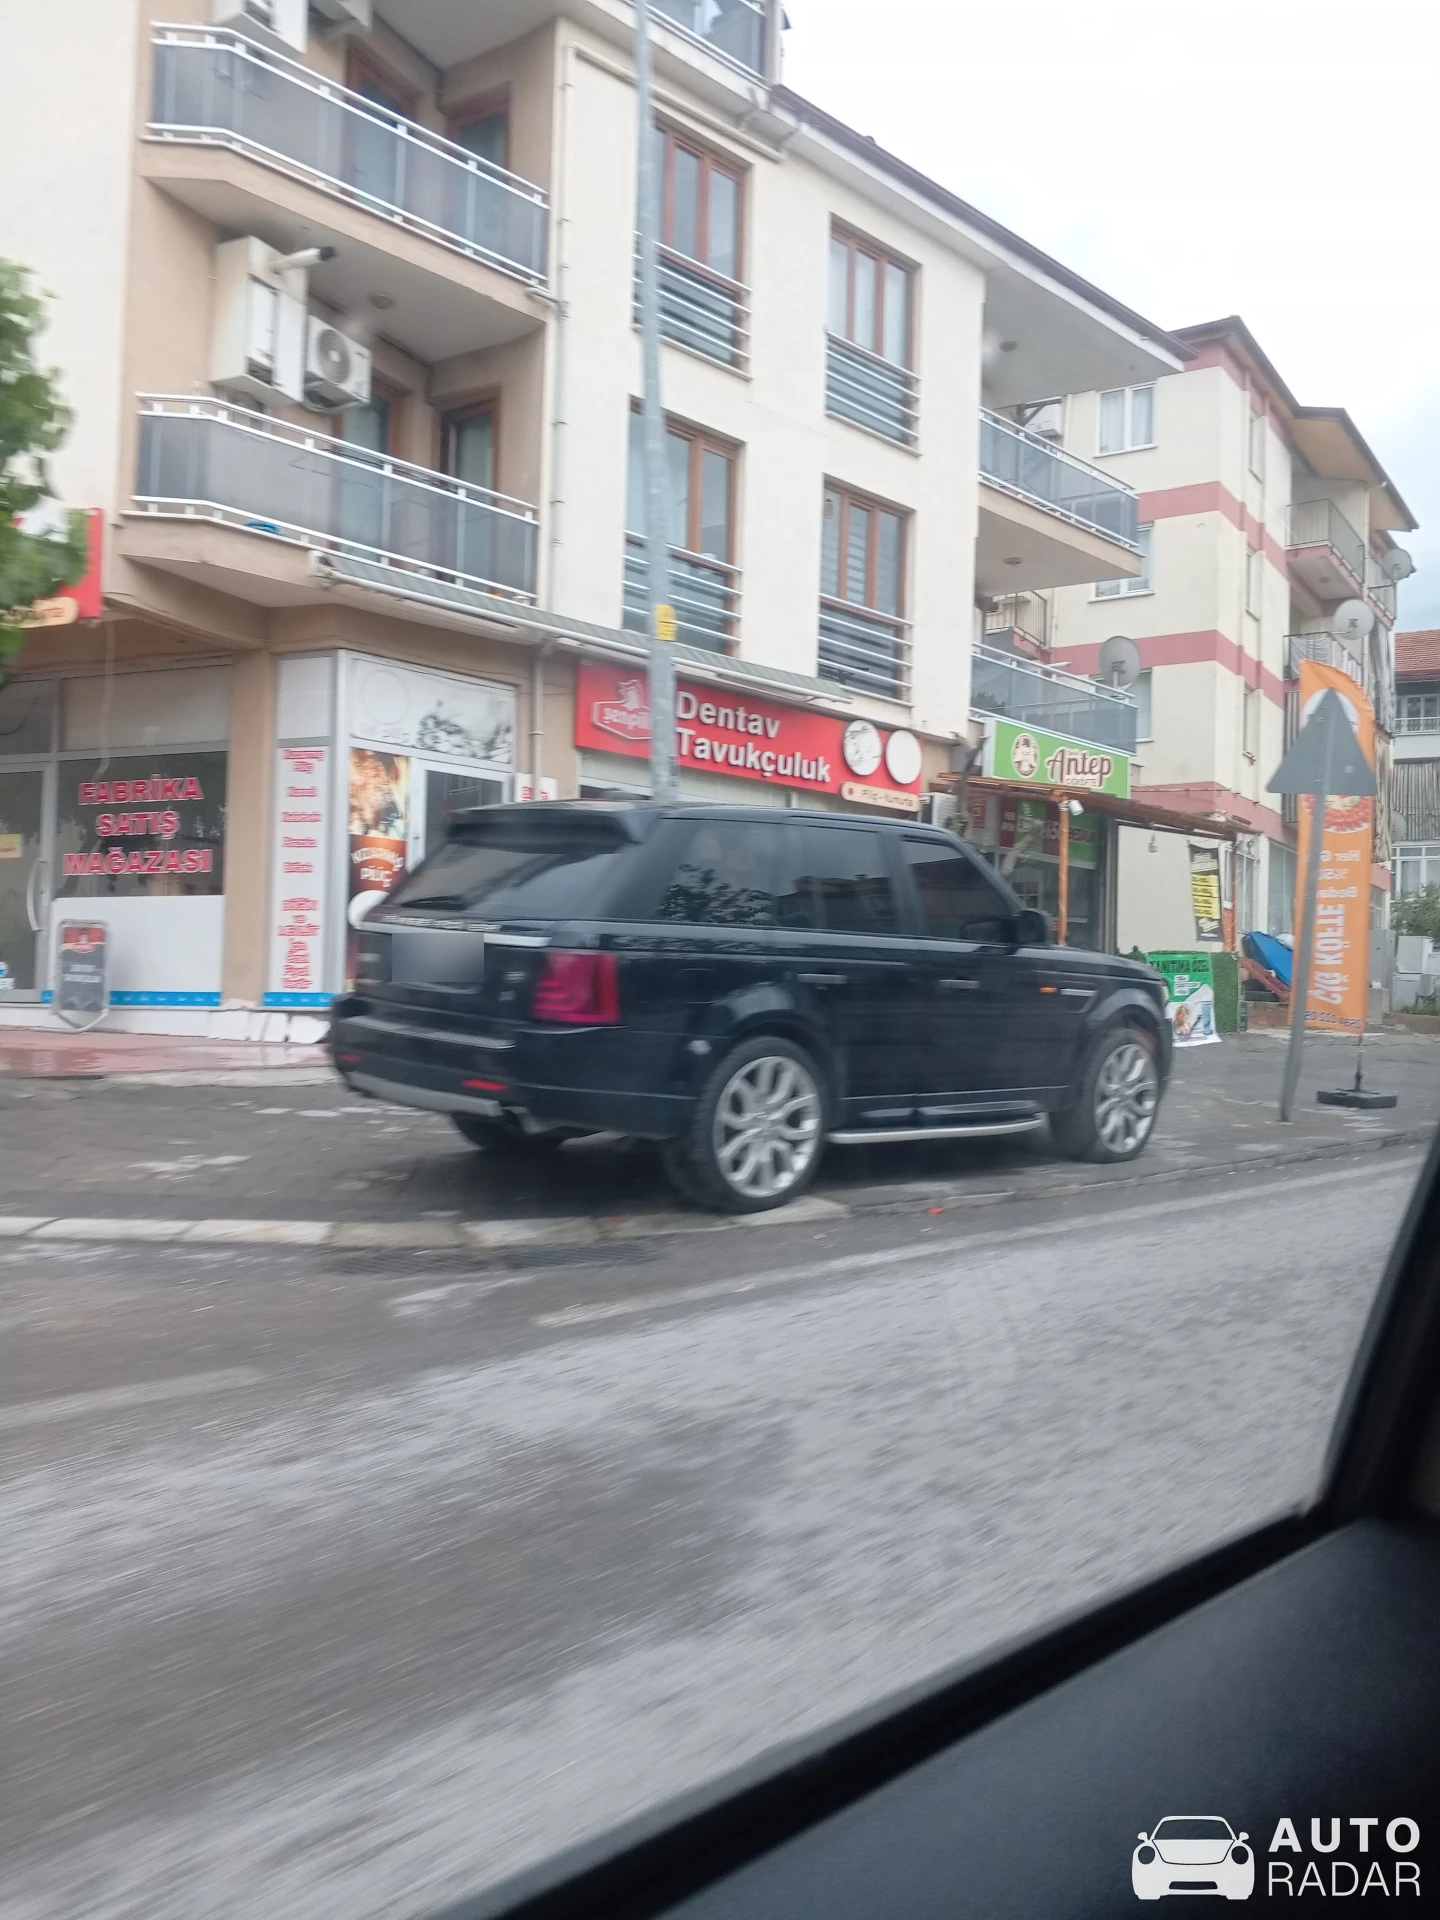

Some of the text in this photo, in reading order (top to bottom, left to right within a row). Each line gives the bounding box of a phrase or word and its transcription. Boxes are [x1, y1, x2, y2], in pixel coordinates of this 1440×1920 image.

[675, 690, 780, 739] Dentav
[675, 726, 831, 782] Tavukçuluk
[1046, 749, 1112, 787] Antep
[78, 773, 204, 805] FABRİKA
[95, 810, 181, 840] SATIŞ
[63, 846, 213, 876] MAĞAZASI
